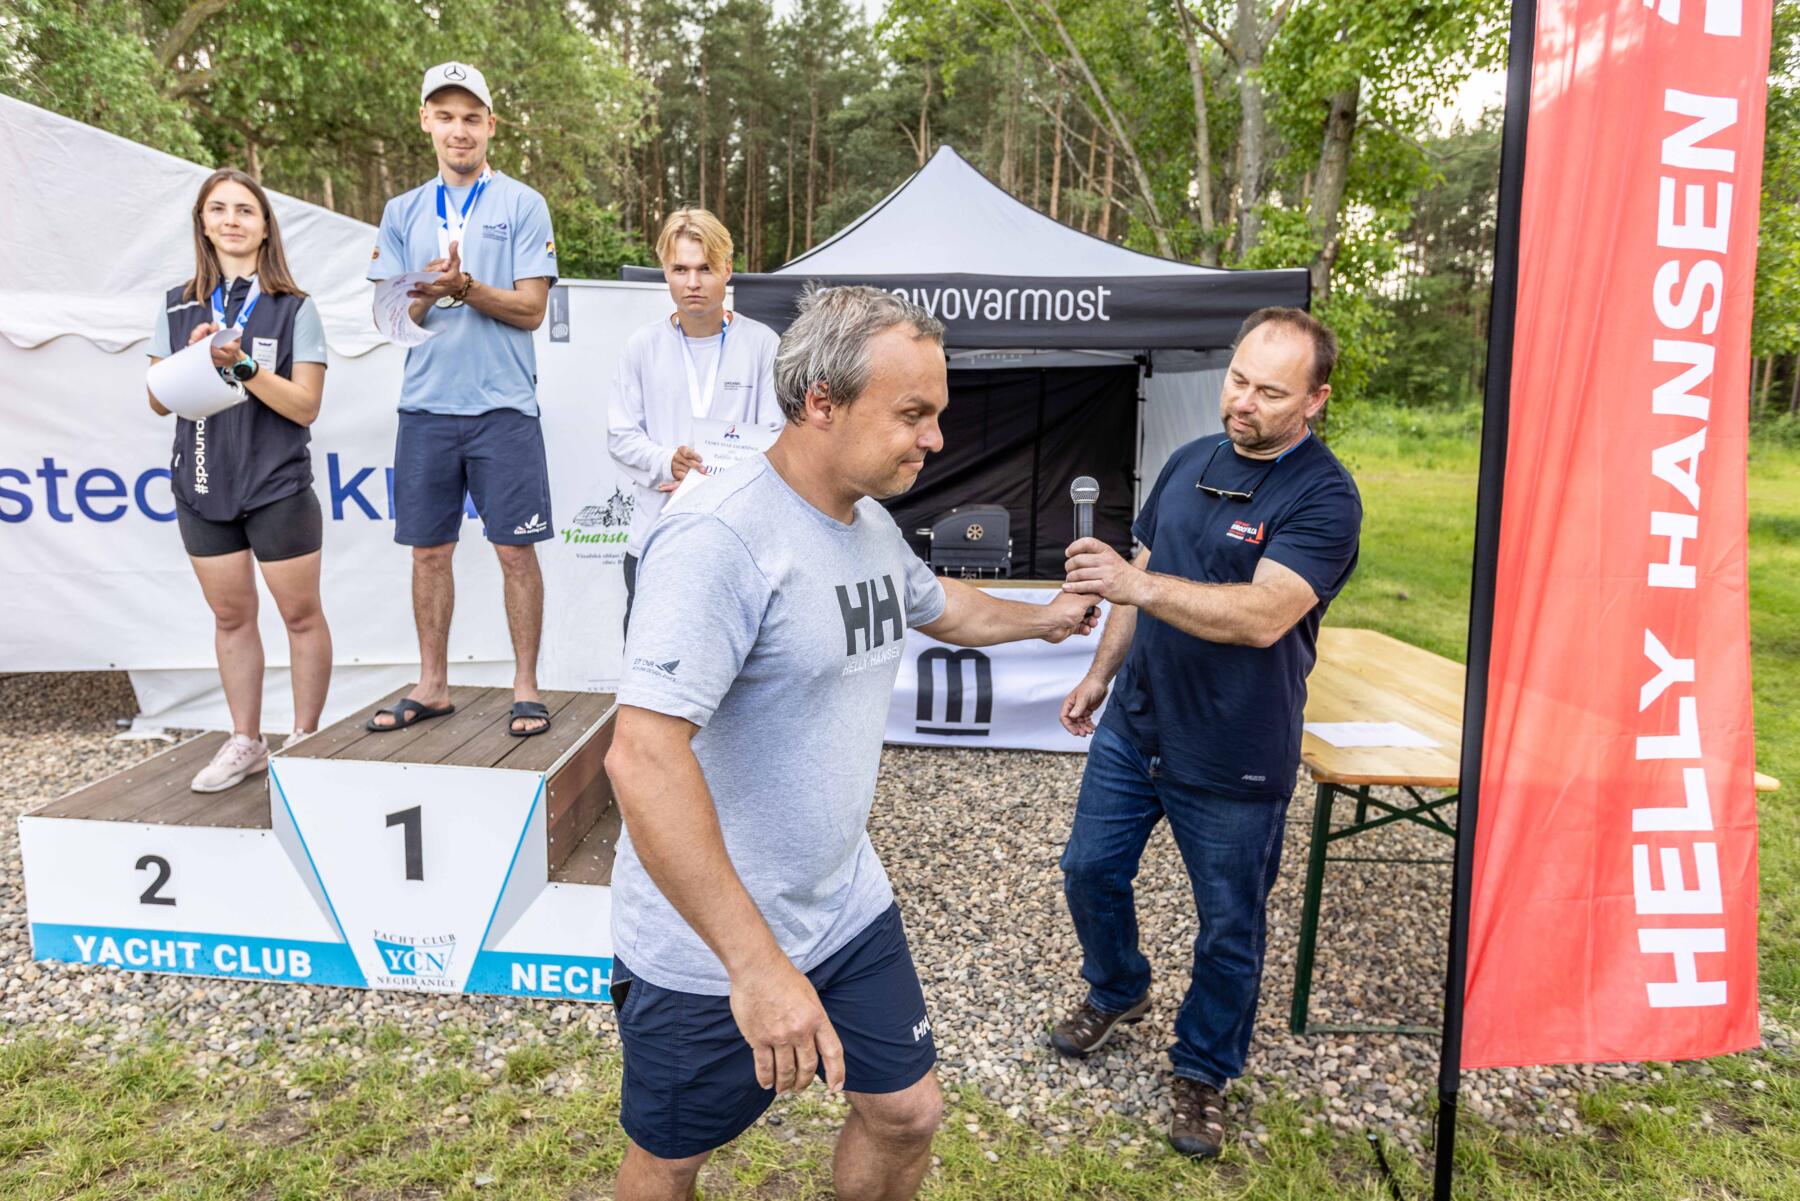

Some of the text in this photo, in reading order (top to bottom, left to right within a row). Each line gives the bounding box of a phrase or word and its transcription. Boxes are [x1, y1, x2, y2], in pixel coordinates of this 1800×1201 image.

[1647, 88, 1738, 589] HANSEN
[195, 411, 209, 495] #spoluna
[834, 574, 903, 657] HH
[385, 804, 425, 881] 1
[1632, 627, 1728, 1009] HELLY
[134, 854, 177, 907] 2
[72, 934, 313, 979] YACHT CLUB
[372, 928, 457, 946] YACHT CLUB
[383, 948, 446, 972] YCN
